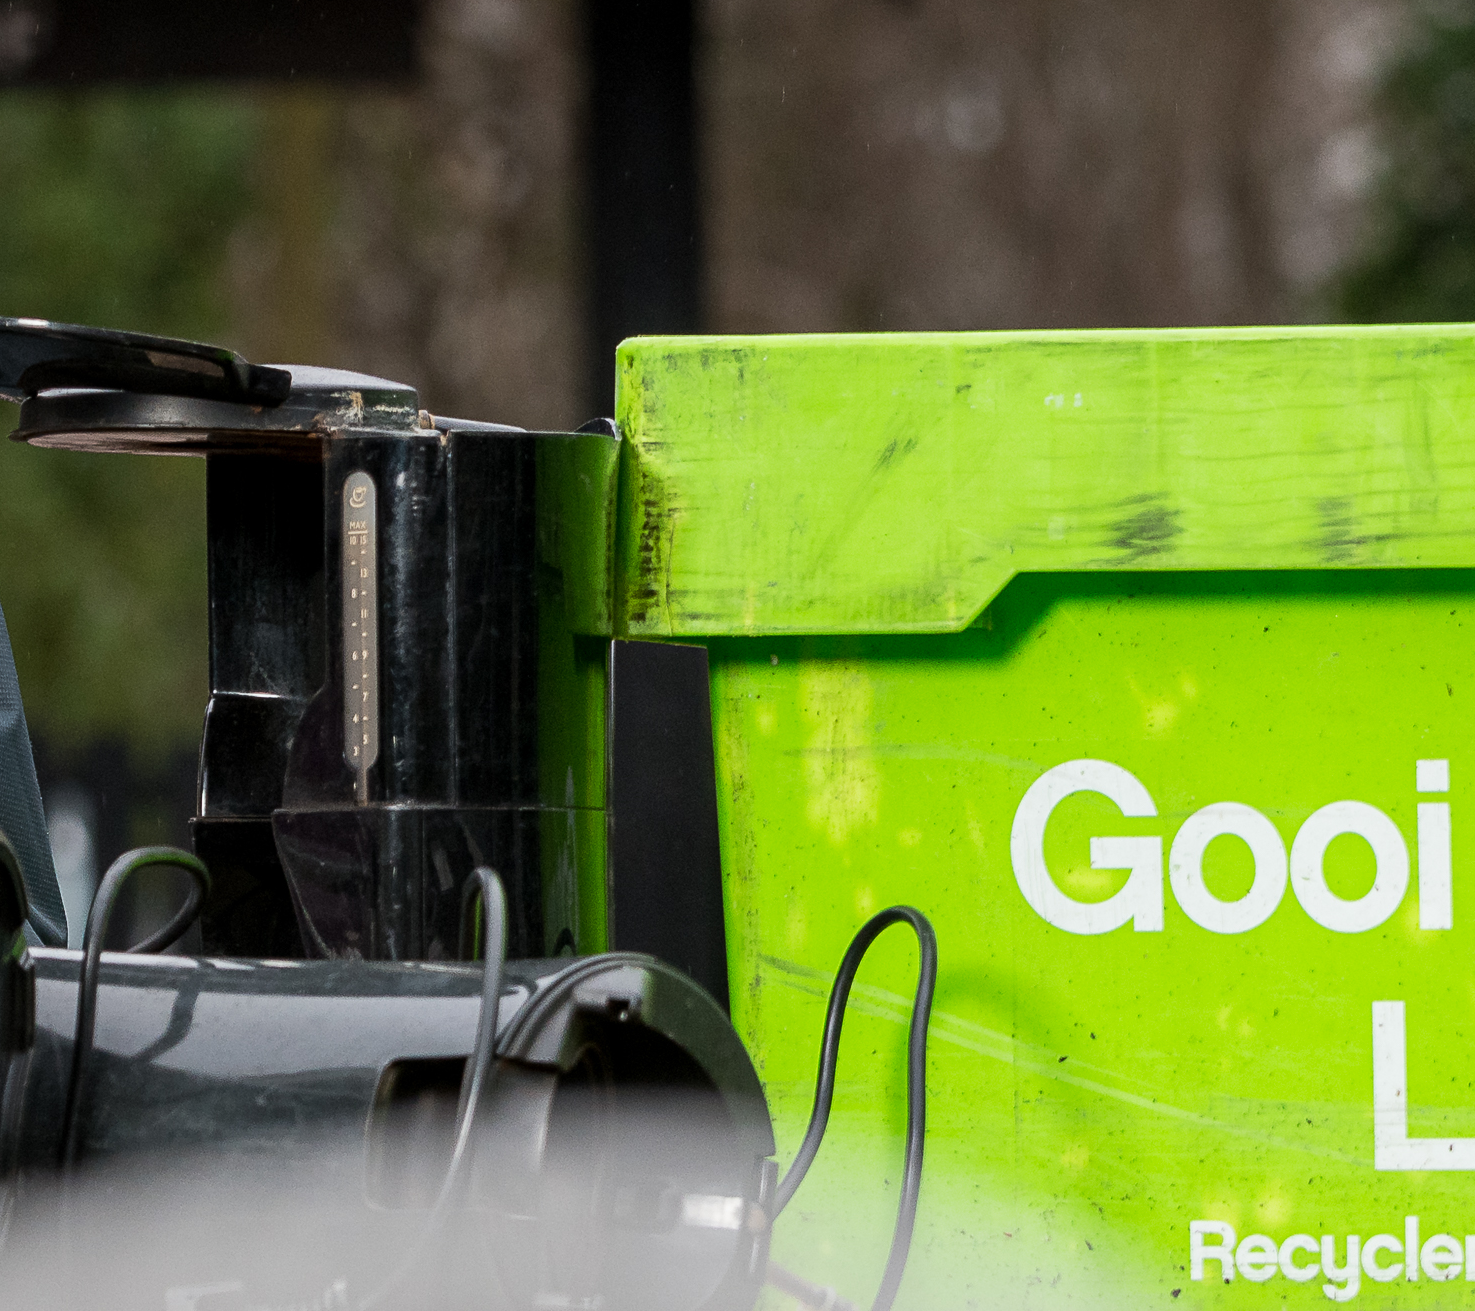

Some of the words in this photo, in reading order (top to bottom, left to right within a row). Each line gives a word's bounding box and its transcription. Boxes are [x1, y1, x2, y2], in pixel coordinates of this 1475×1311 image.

[349, 520, 367, 530] MAX
[359, 535, 368, 546] 15
[360, 567, 369, 579] 13
[351, 588, 358, 599] 8
[360, 608, 368, 619] 11
[351, 650, 358, 661] 6
[361, 649, 369, 660] 9
[362, 691, 369, 703] 7
[352, 713, 360, 724] 4
[362, 734, 369, 745] 5
[352, 745, 360, 757] 3
[1010, 758, 1453, 936] Gooi
